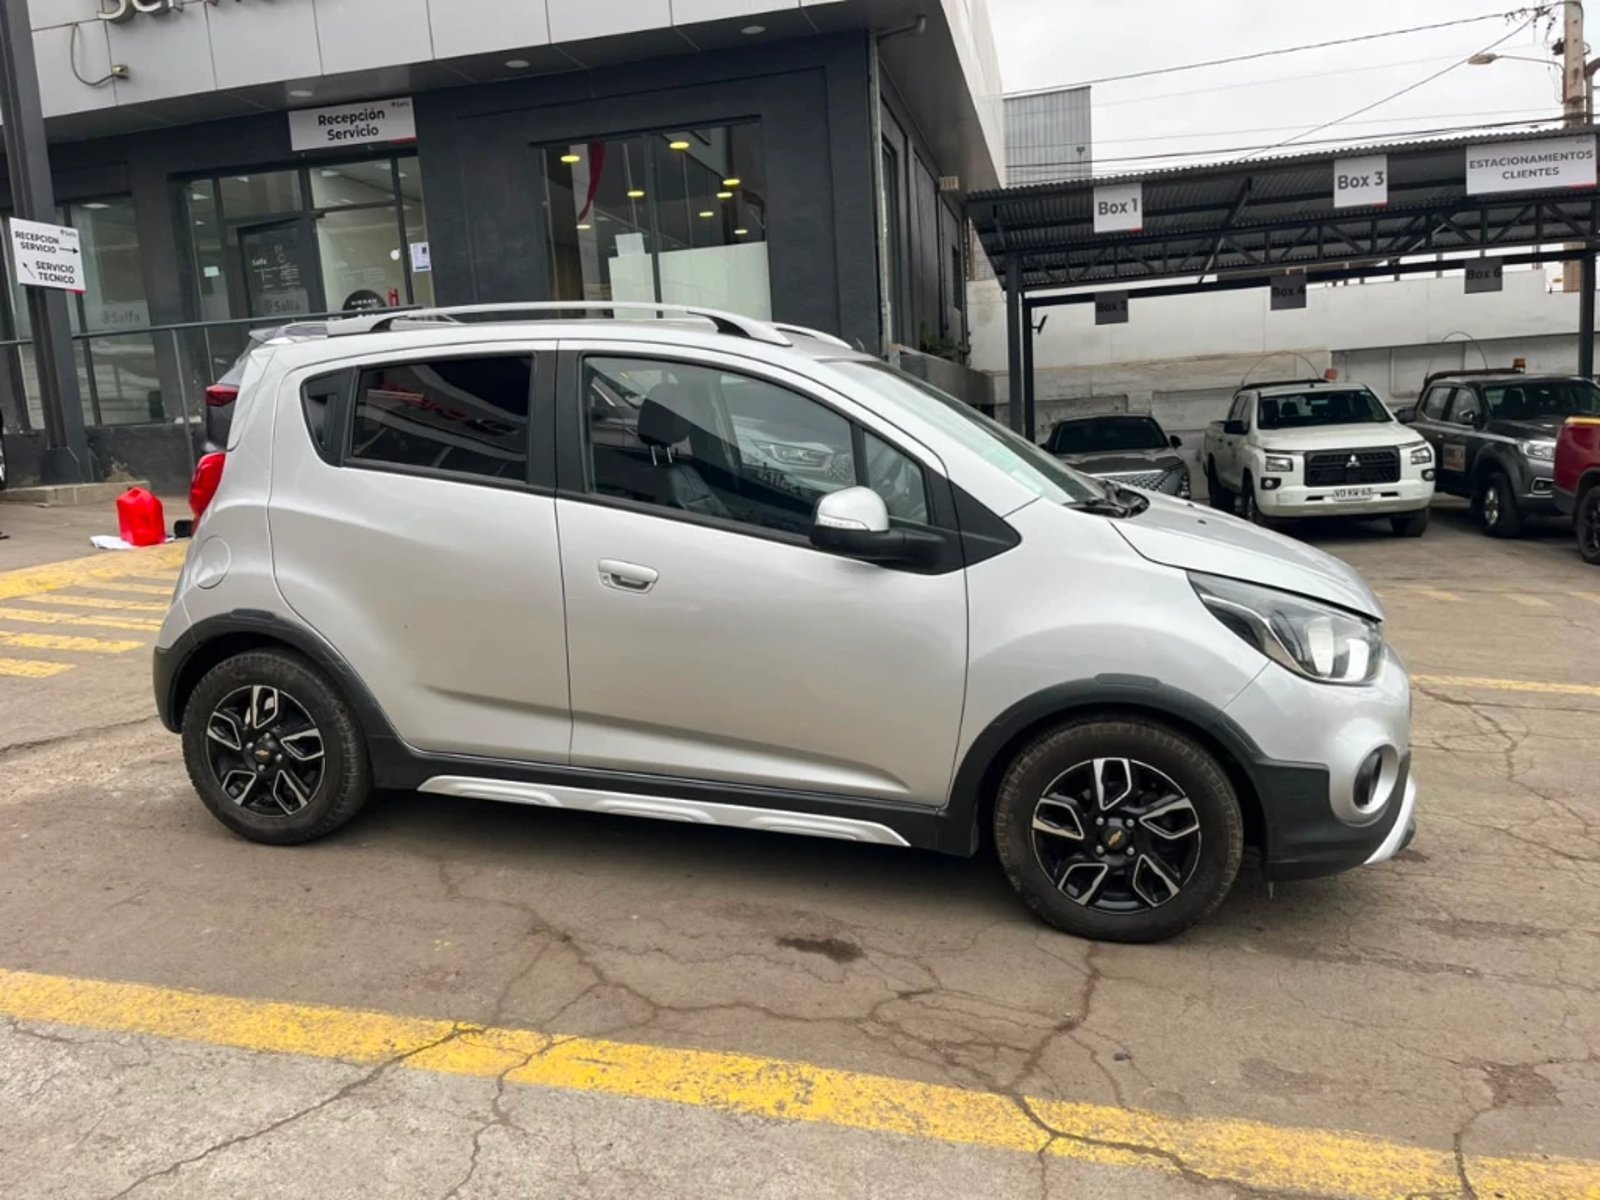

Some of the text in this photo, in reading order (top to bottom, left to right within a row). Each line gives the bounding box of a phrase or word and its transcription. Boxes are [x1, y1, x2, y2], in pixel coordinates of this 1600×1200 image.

[318, 107, 385, 126] Recepción
[327, 124, 379, 141] Servicio
[1469, 150, 1593, 169] ESTACIONAMIENTOS
[1502, 167, 1560, 179] CLIENTES
[1338, 171, 1384, 190] Box 3
[1098, 198, 1138, 215] Box 1
[14, 231, 59, 244] RECEPCION
[20, 241, 57, 254] SERVICIO
[35, 260, 75, 274] SERVICIO
[38, 271, 75, 284] TECNICO
[1466, 269, 1490, 280] Box
[1272, 287, 1293, 297] Box
